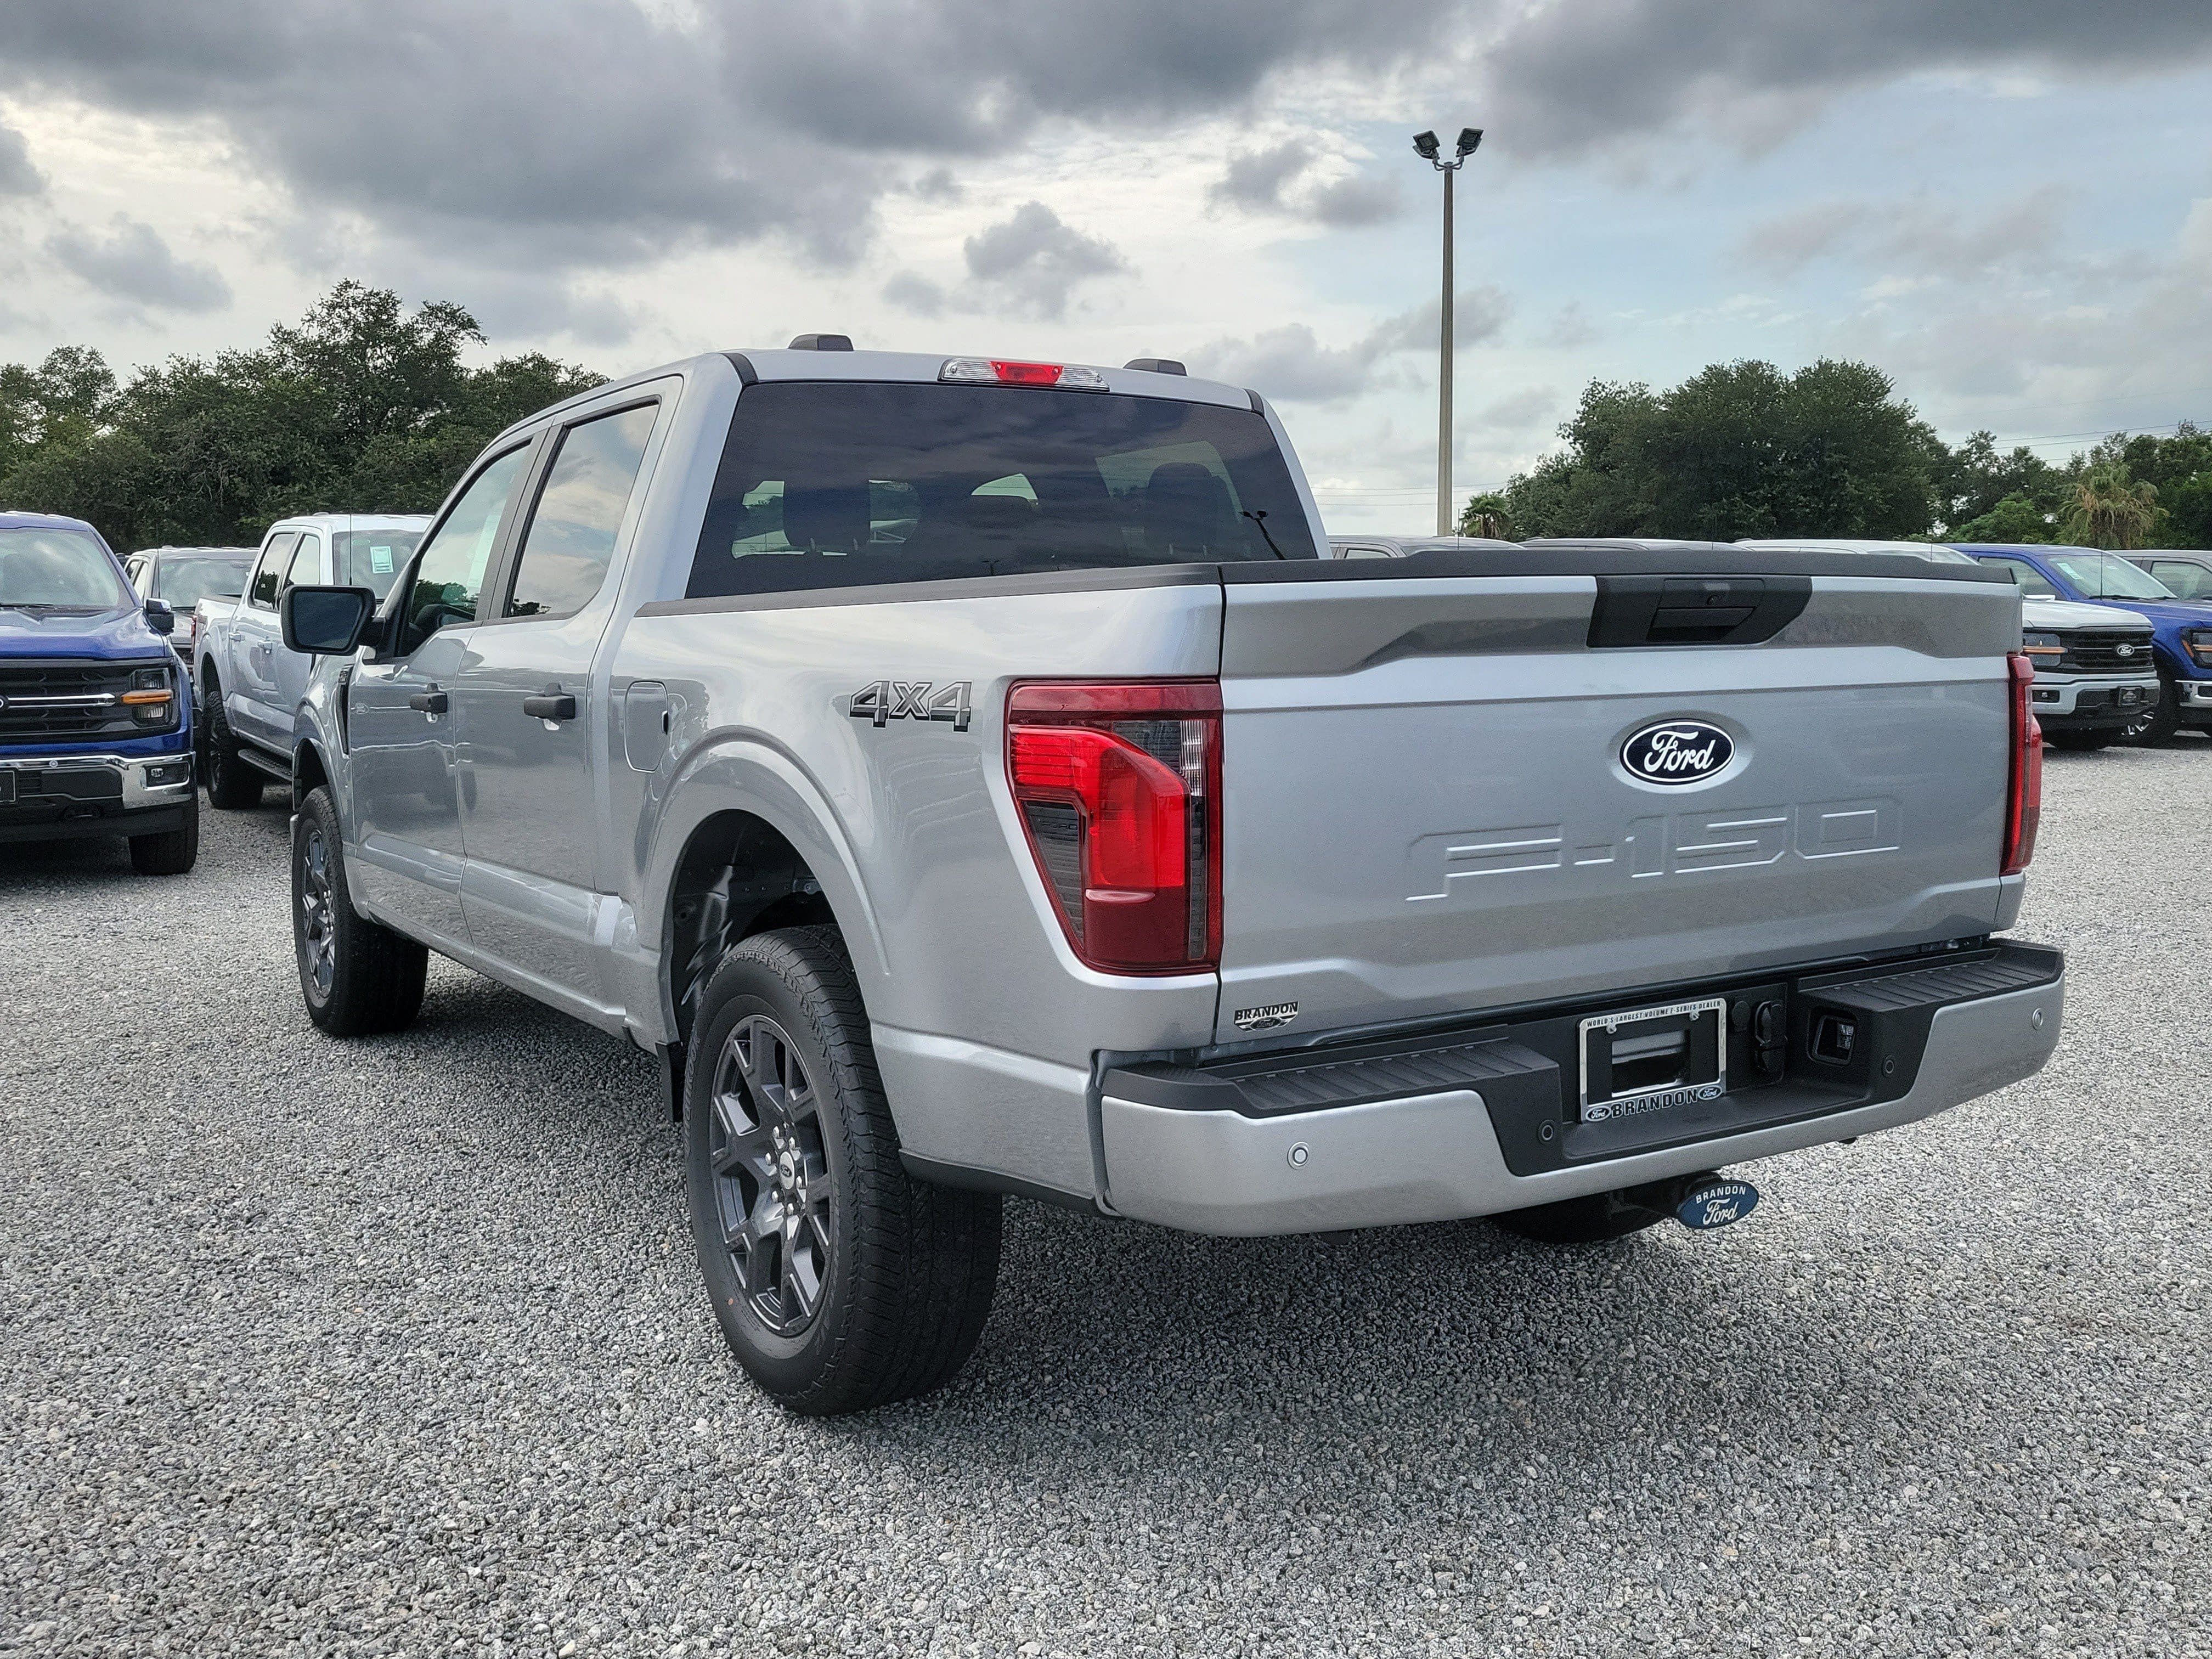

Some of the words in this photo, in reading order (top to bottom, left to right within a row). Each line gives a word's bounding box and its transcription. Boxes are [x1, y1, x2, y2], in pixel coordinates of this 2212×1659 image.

[1644, 731, 1714, 772] Ford
[1406, 794, 1902, 900] F-150
[1234, 1001, 1299, 1021] BRANDON
[1256, 1019, 1275, 1028] Ford
[1587, 1017, 1614, 1029] WORLD'S
[1616, 1012, 1643, 1023] LARGEST
[1645, 1008, 1668, 1018] VOLUME
[1669, 1003, 1697, 1014] F-SERIES
[1699, 1001, 1722, 1010] DEALER
[1590, 1109, 1606, 1119] Ford
[1611, 1088, 1698, 1119] BRANDON
[1702, 1087, 1718, 1098] Ford
[1696, 1185, 1746, 1204] BRANDON
[1702, 1197, 1739, 1225] Ford
